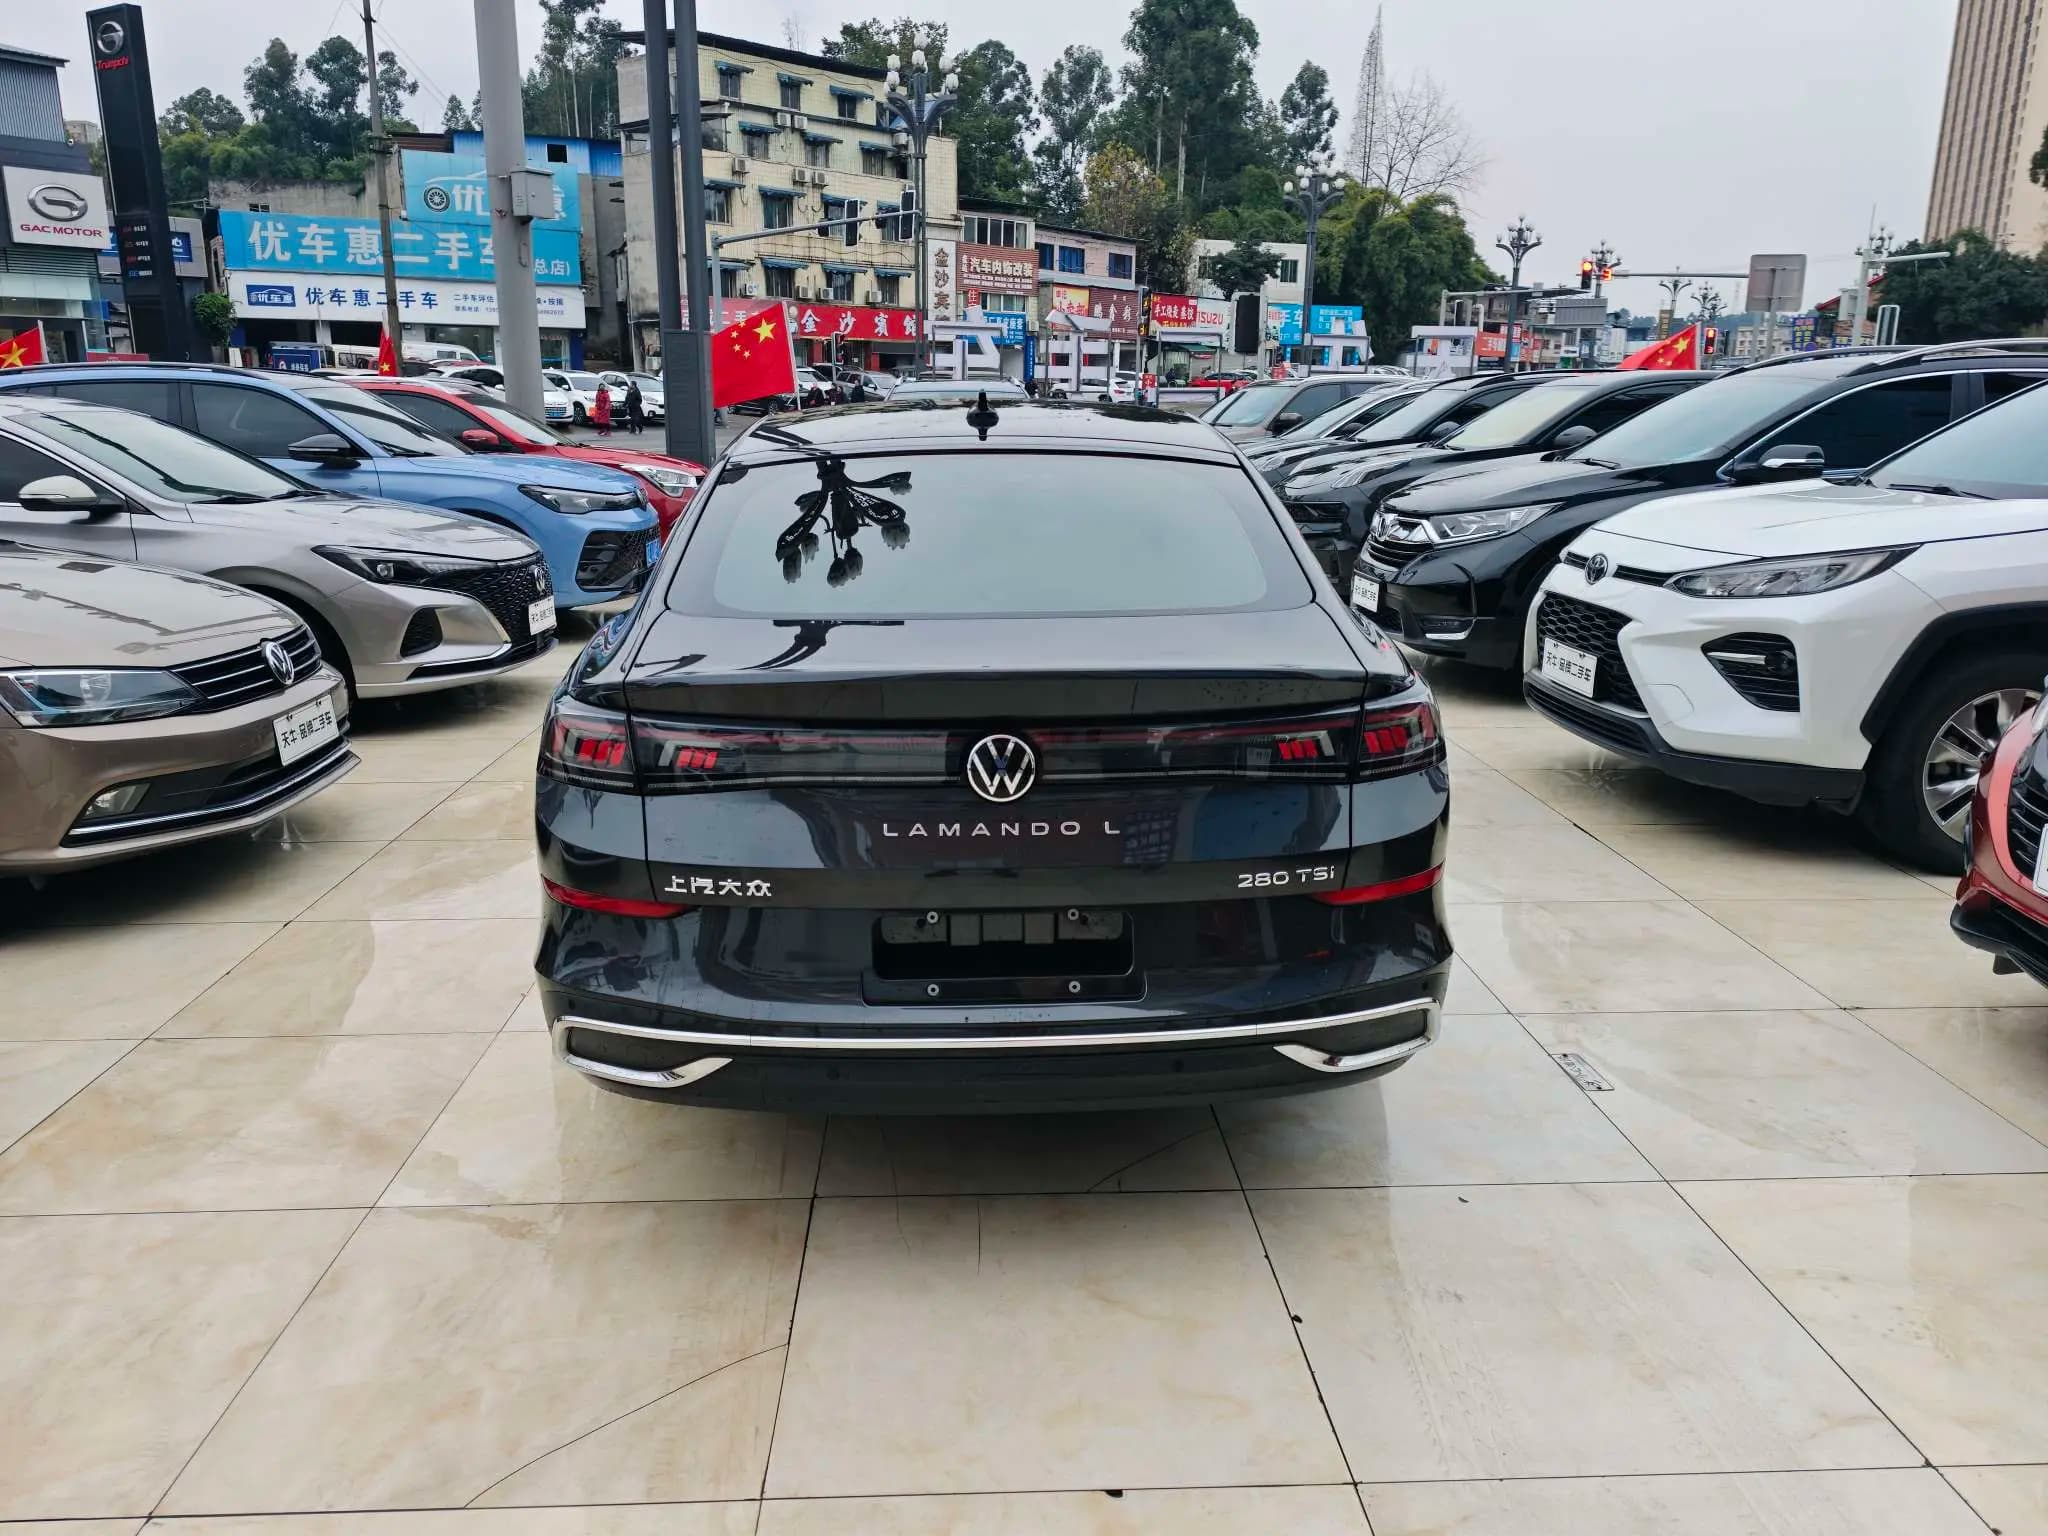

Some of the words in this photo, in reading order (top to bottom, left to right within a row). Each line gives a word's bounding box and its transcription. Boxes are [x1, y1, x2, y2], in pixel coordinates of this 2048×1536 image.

[20, 224, 51, 234] GAC
[53, 227, 103, 238] MOTOR
[305, 287, 439, 310] 优车惠二手车
[883, 821, 1081, 837] LAMANDO
[1104, 821, 1121, 835] L
[664, 875, 772, 896] 上汽大众
[1238, 871, 1290, 888] 280
